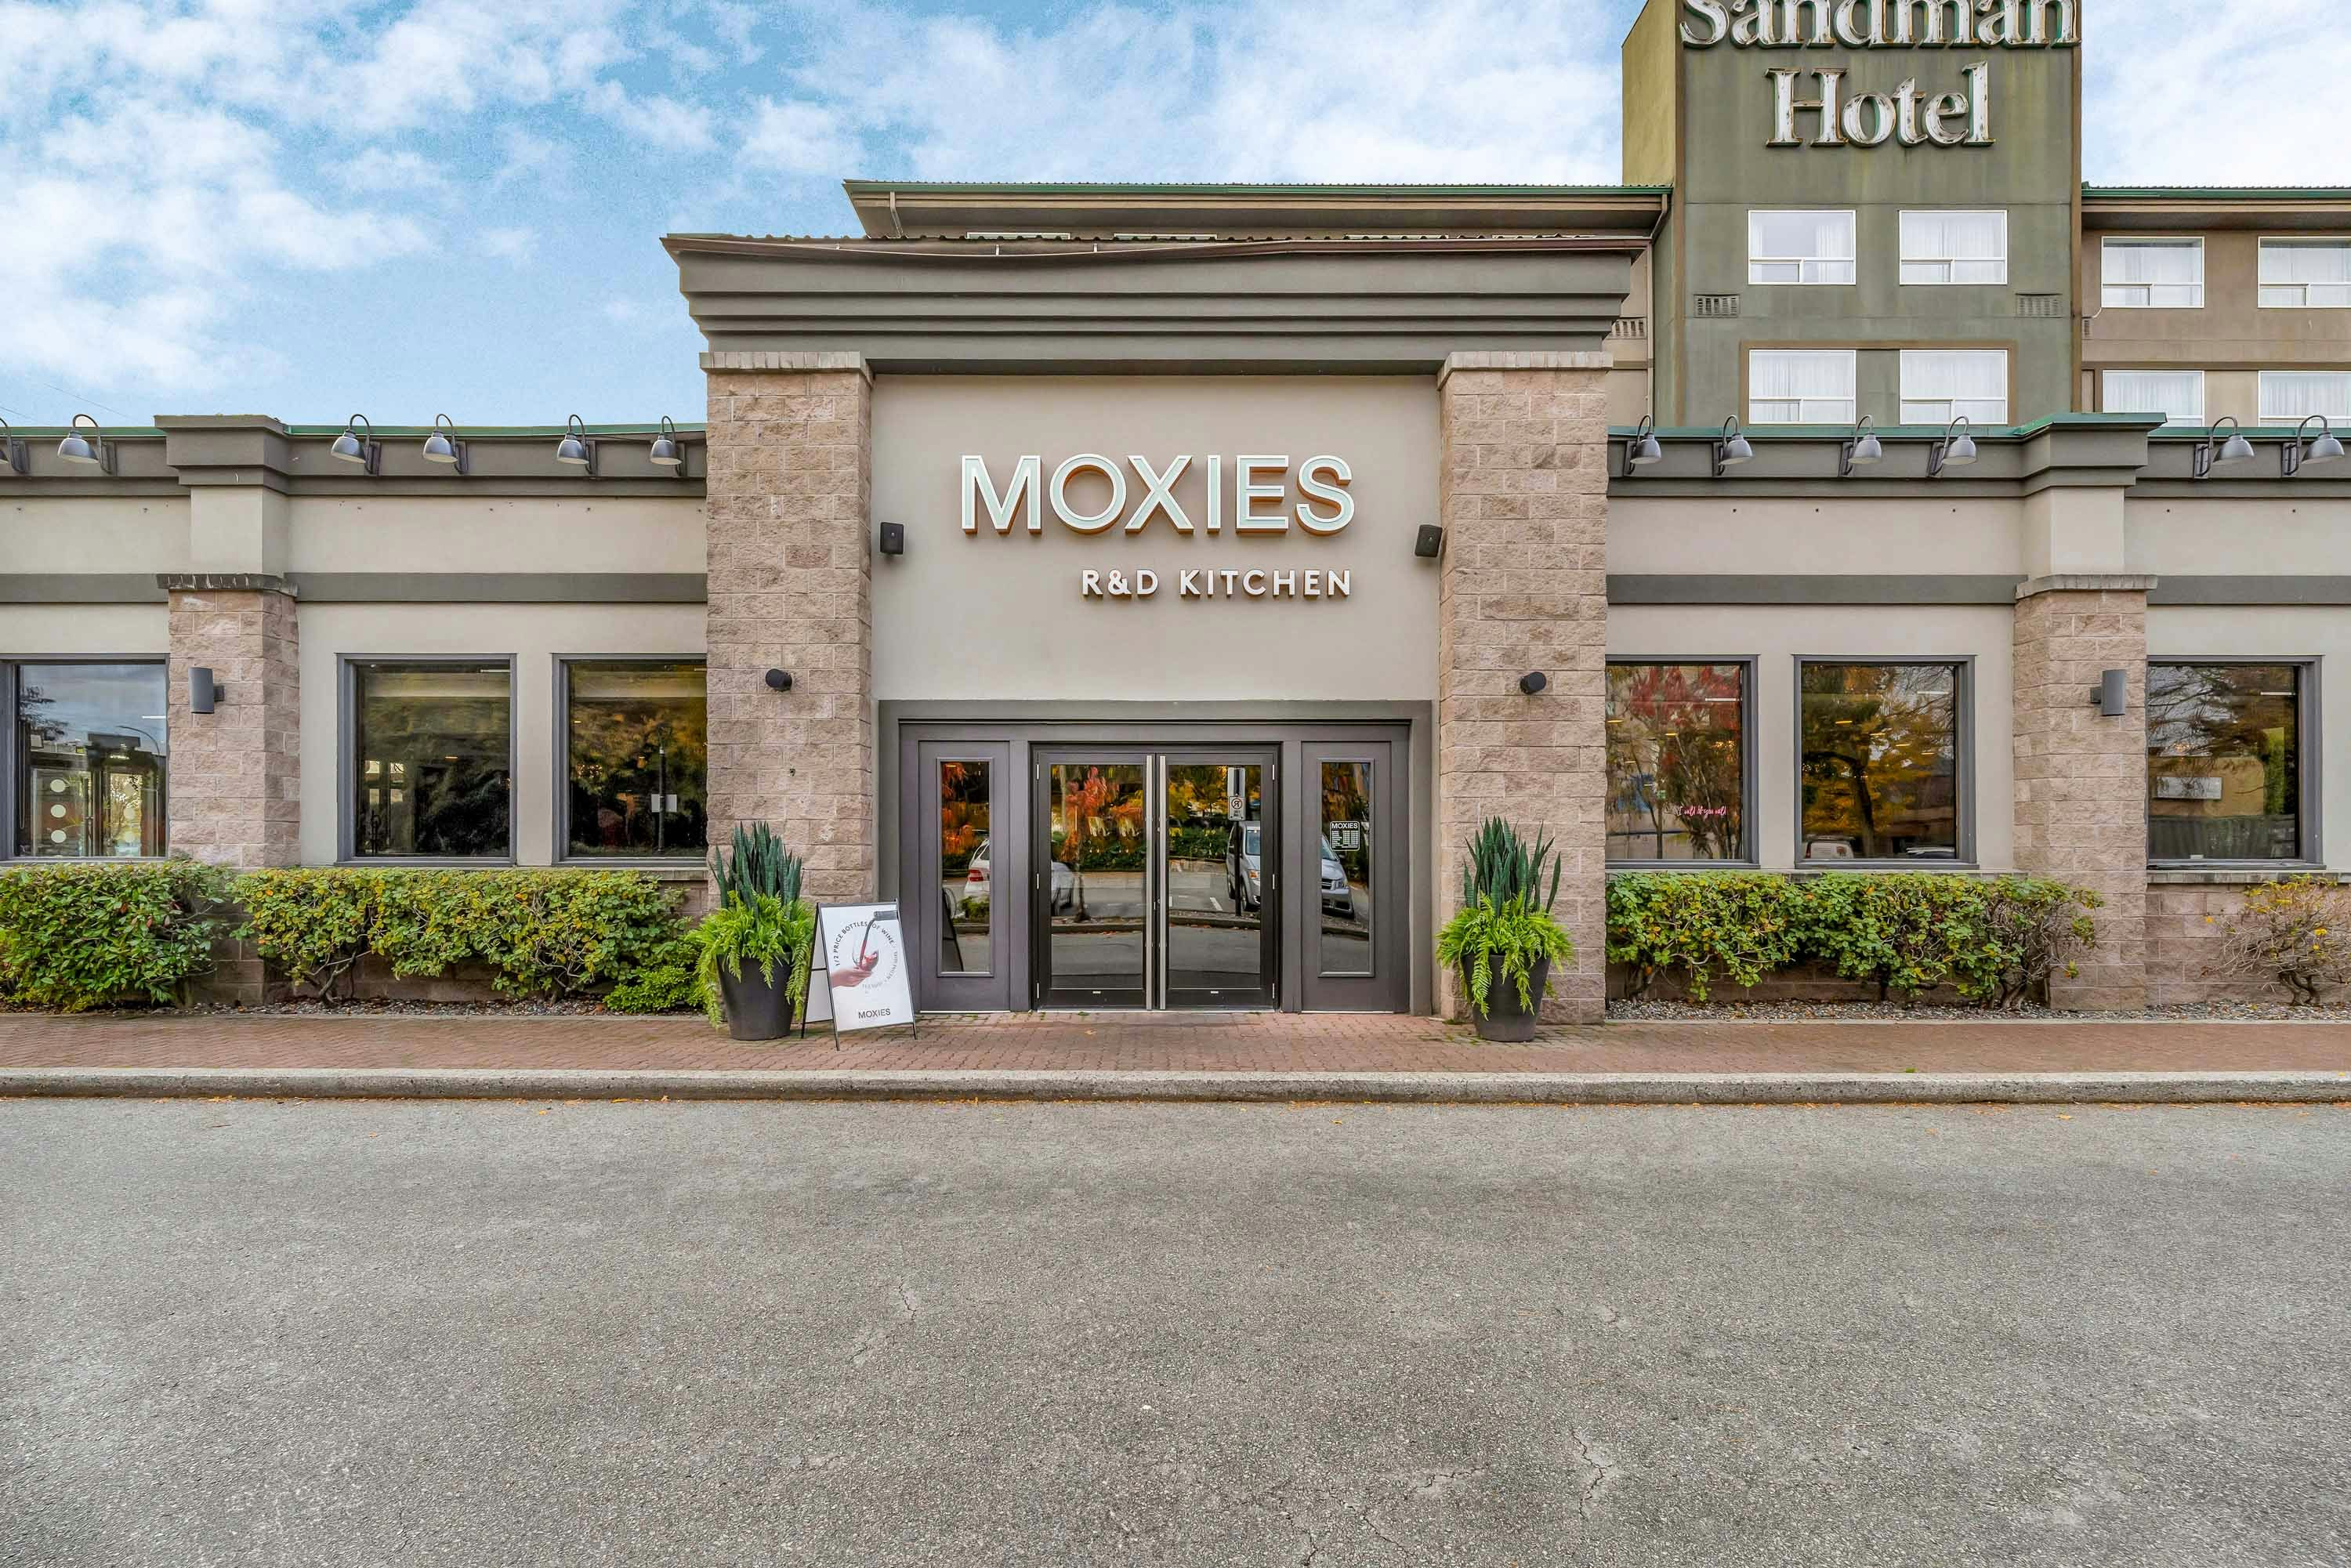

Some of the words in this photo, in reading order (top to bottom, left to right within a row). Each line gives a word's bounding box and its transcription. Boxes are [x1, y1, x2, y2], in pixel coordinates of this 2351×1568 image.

[1680, 0, 2081, 49] Sandman
[1765, 60, 1996, 147] Hotel
[961, 454, 1356, 536] MOXIES
[1081, 569, 1159, 596] R&D
[1179, 569, 1350, 596] KITCHEN
[833, 933, 843, 954] PRICE
[841, 921, 868, 935] BOTTLES
[881, 929, 895, 945] WINE
[858, 1008, 891, 1019] MOXIES
